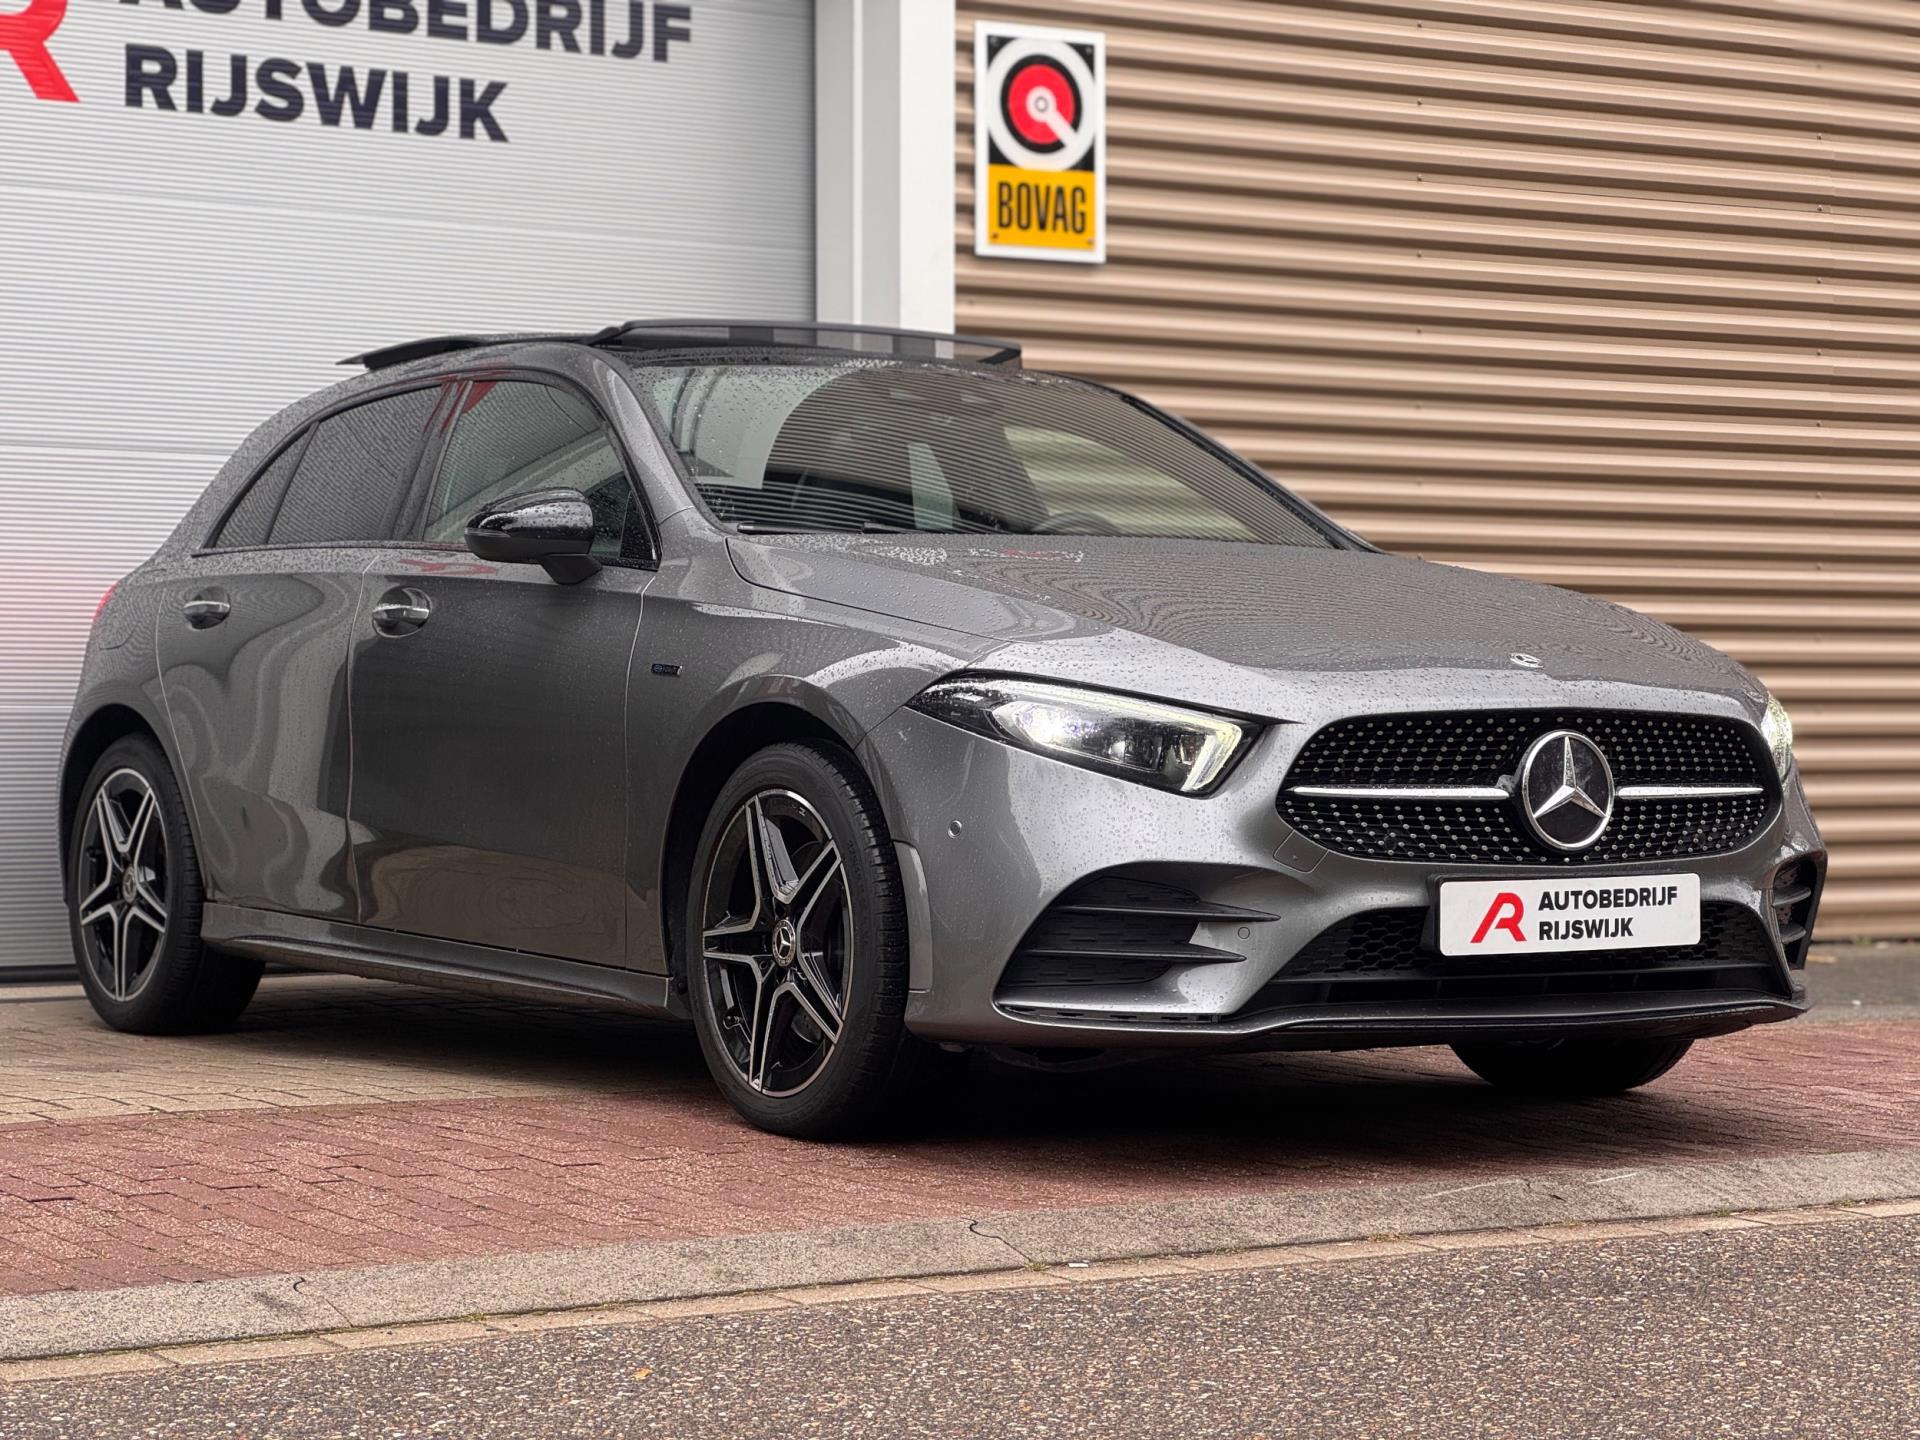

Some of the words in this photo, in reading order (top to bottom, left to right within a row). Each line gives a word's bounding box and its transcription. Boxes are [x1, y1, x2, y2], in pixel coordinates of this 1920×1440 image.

[119, 0, 691, 62] BEDRIJF
[125, 43, 508, 143] RIJSWIJK
[998, 181, 1087, 235] BOVAG
[1538, 886, 1678, 911] AUTOBEDRIJF
[1539, 917, 1634, 941] RIJSWIJK
